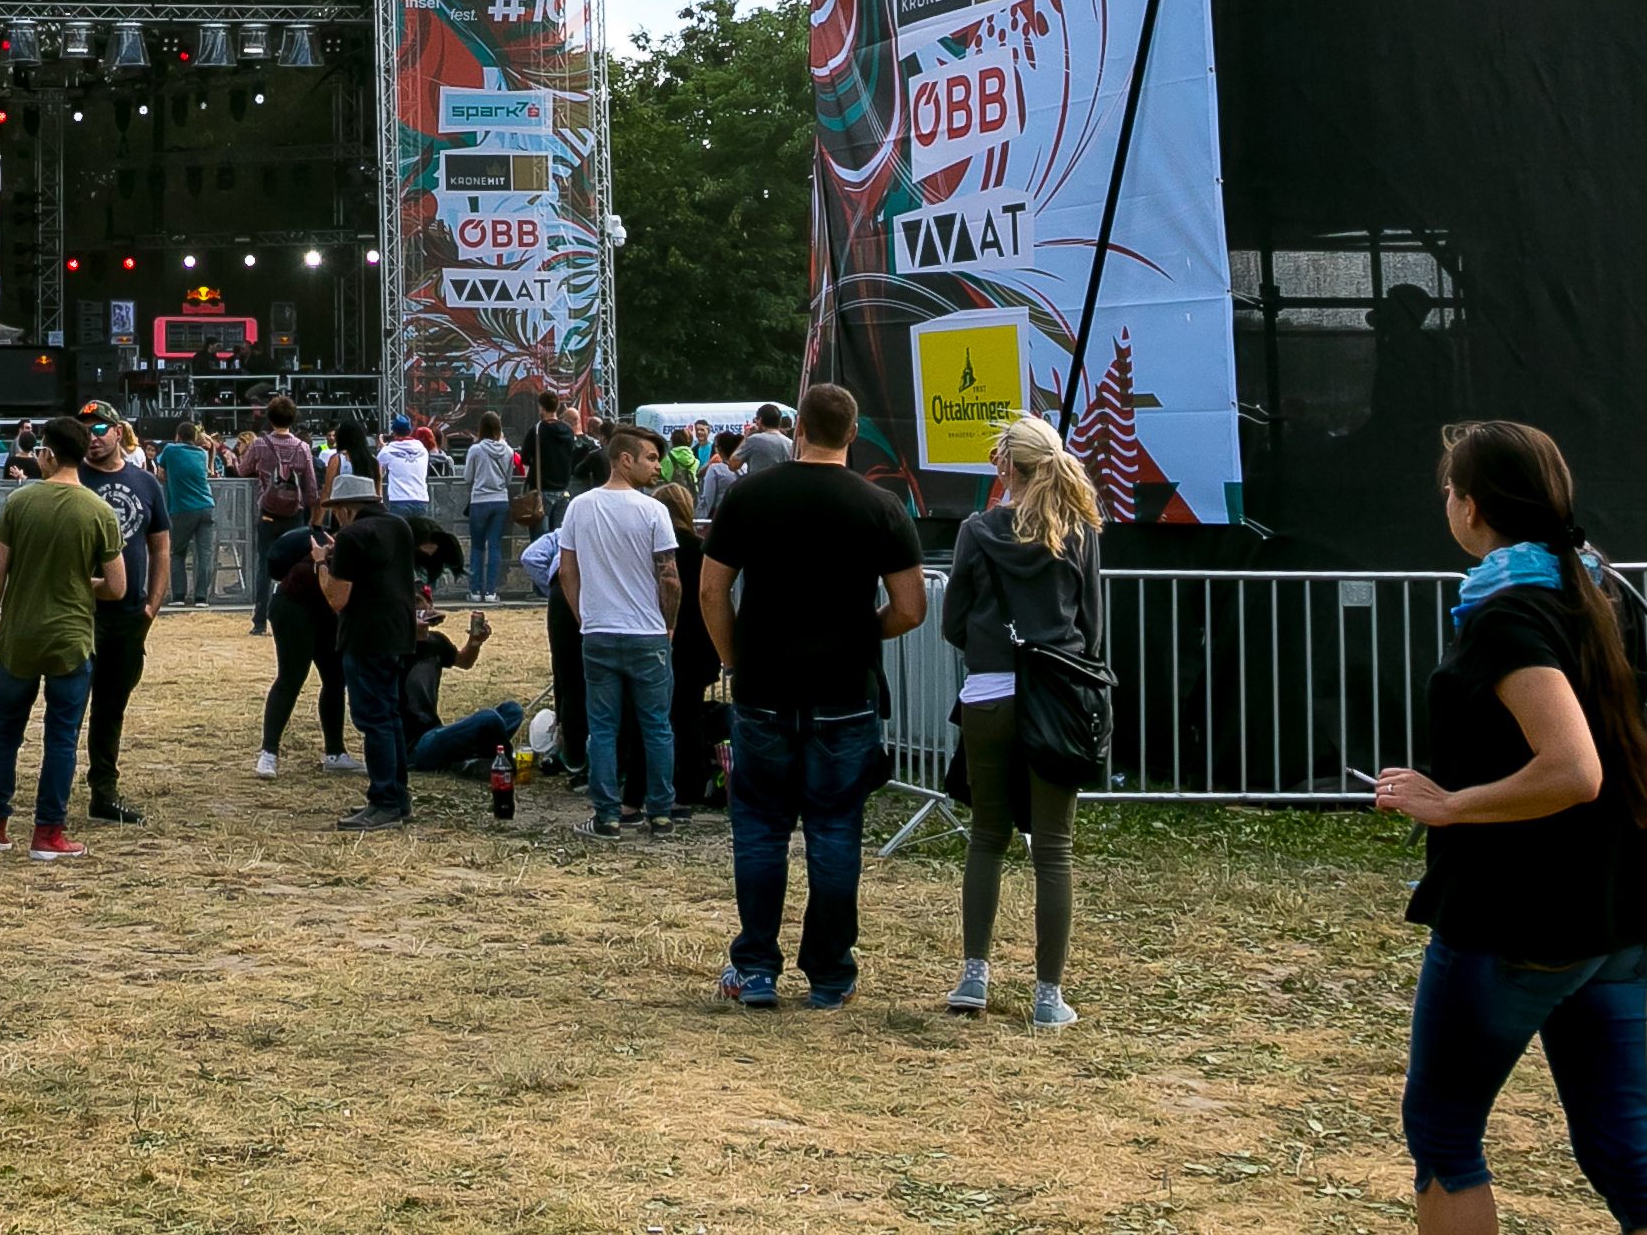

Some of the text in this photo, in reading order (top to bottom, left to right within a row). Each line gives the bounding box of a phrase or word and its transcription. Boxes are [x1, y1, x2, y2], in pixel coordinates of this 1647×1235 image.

[449, 8, 478, 21] fest.
[451, 101, 530, 121] spark7
[913, 66, 1008, 147] ÖBB
[450, 176, 506, 186] KRONEHIT
[458, 218, 540, 249] ÖBB
[931, 394, 1011, 428] Ottakringer
